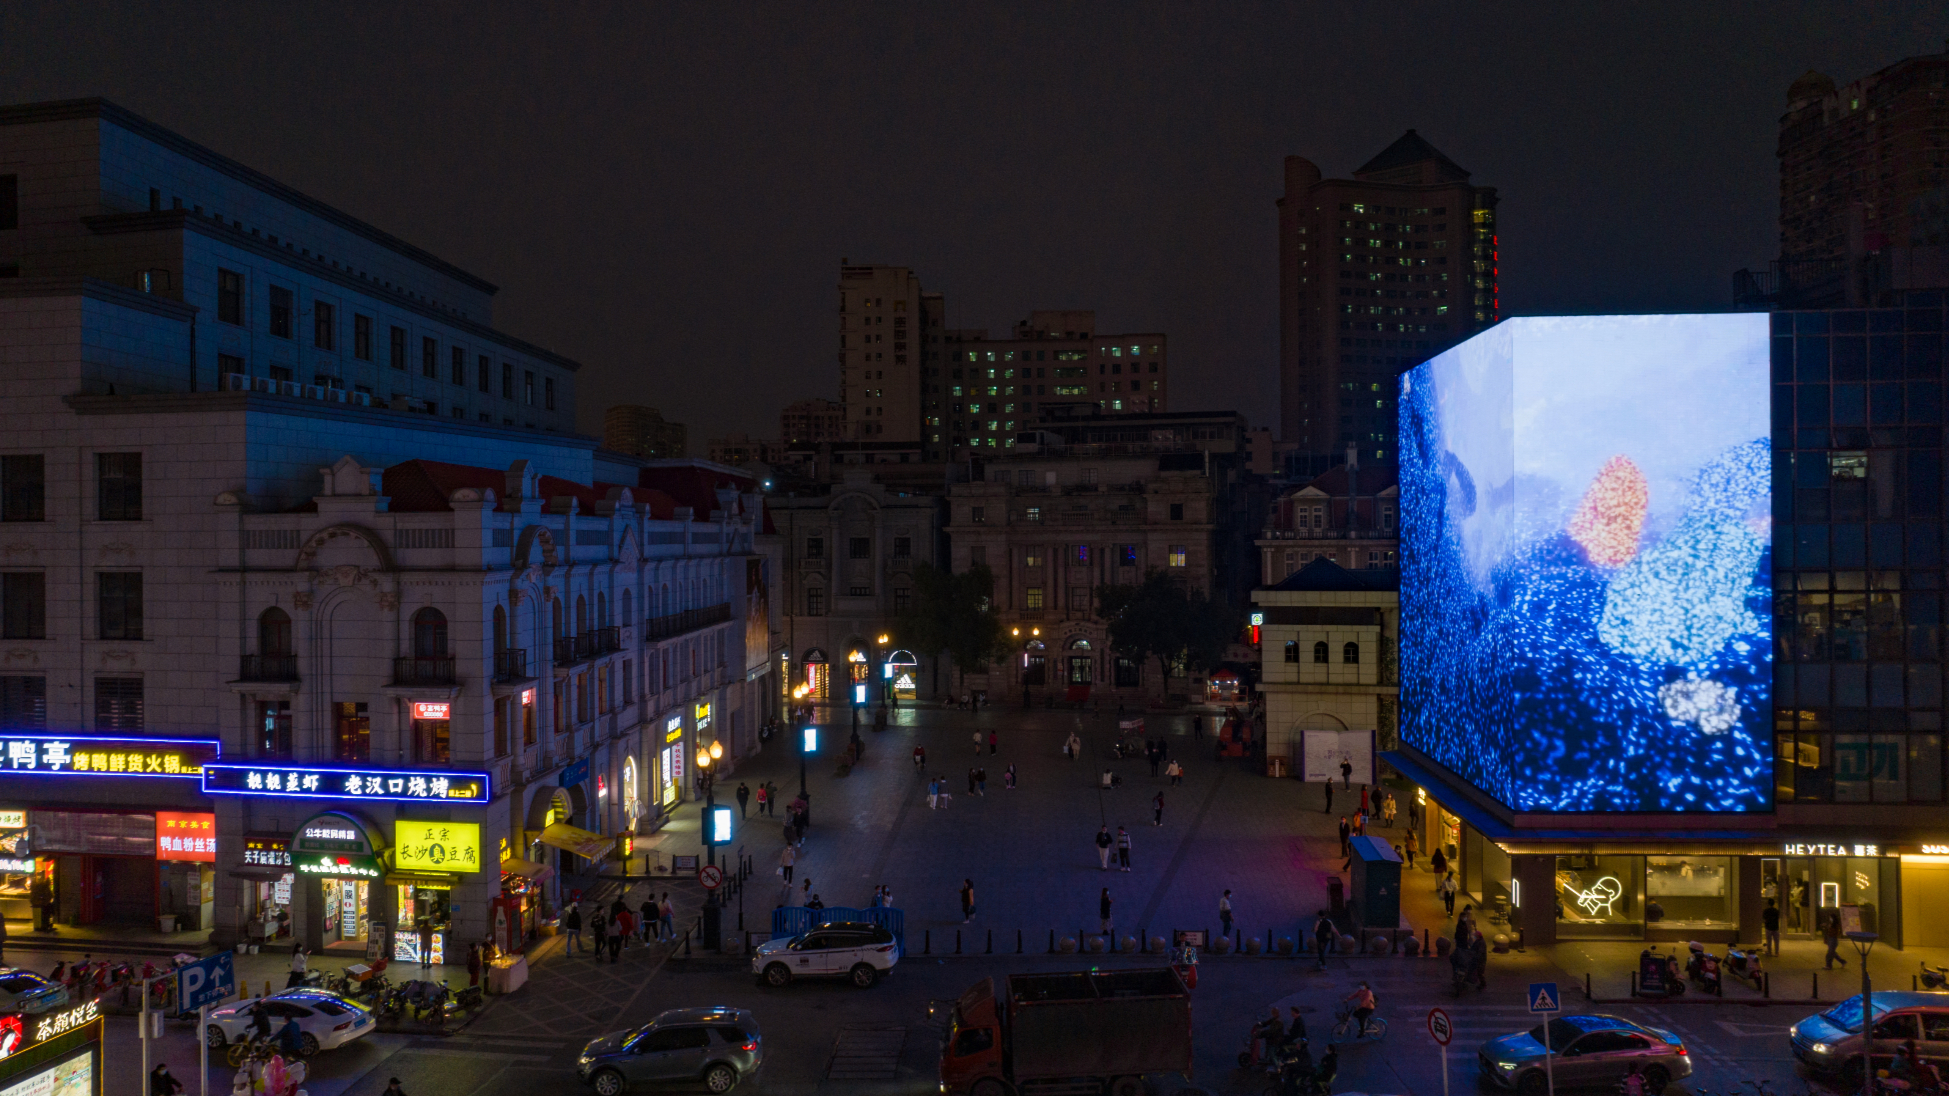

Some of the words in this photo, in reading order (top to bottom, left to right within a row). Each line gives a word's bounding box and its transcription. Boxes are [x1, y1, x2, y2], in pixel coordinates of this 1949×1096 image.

[0, 740, 71, 770] 鸭亭
[73, 752, 180, 774] 烤鸭鲜货火锅
[247, 771, 319, 792] 靓靓蒸虾
[344, 774, 449, 799] 老汉口烧烤
[166, 820, 210, 829] 南京美食
[424, 827, 450, 841] 正宗
[160, 836, 216, 852] 鸭血粉丝汤
[1785, 844, 1847, 855] HEYTEA
[1854, 845, 1878, 856] 喜茶
[400, 843, 476, 865] 长沙臭豆腐
[183, 966, 206, 1009] P
